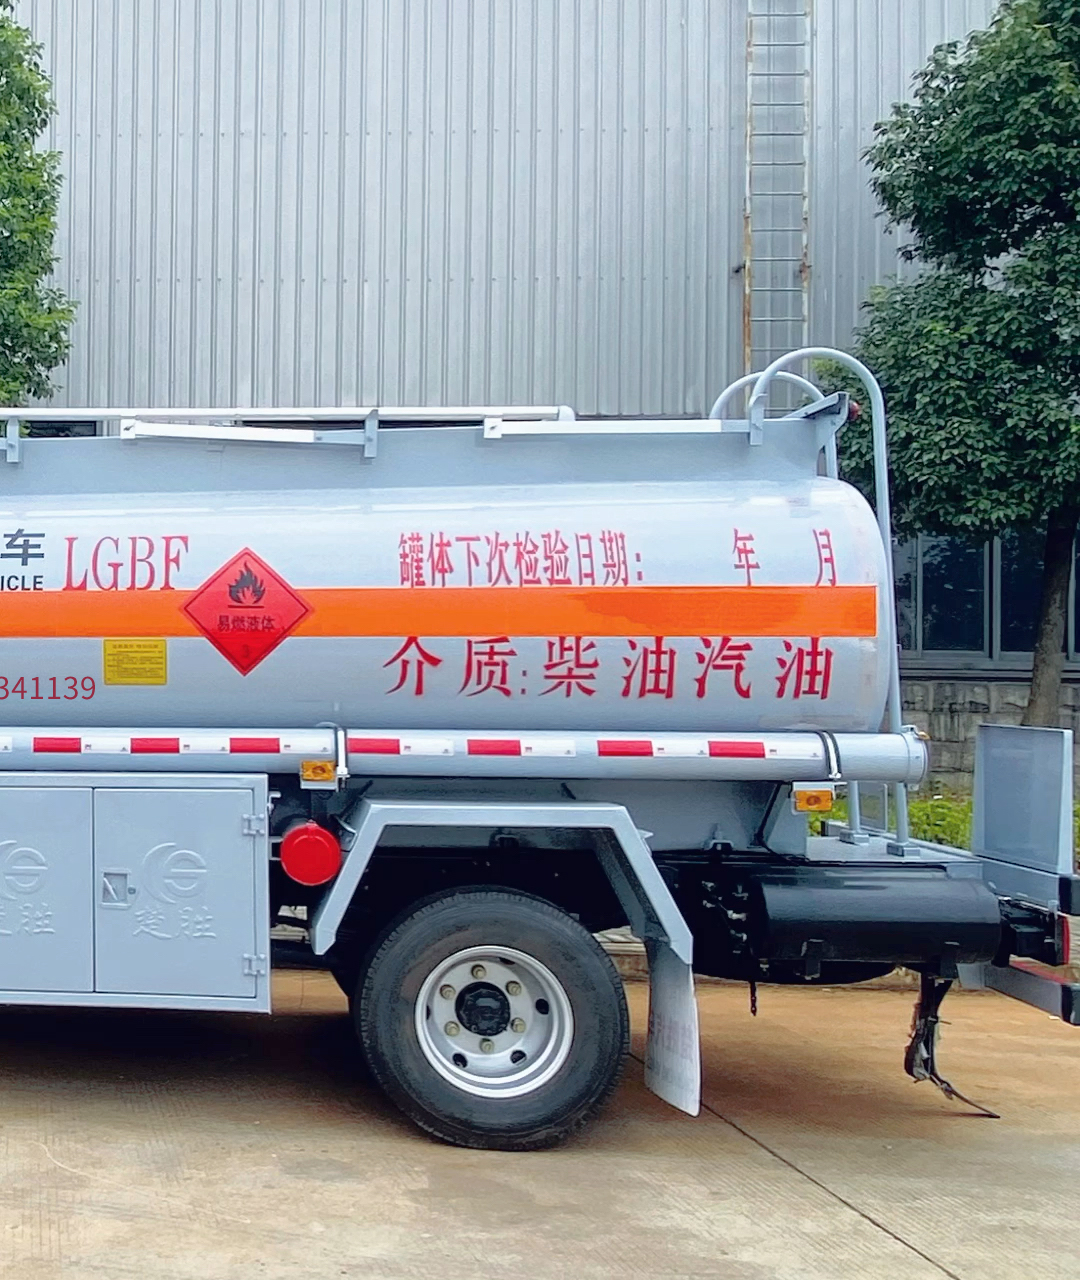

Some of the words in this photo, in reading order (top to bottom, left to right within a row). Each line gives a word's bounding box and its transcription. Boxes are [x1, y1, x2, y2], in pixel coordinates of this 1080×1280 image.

[61, 535, 189, 591] LGBF
[732, 528, 761, 586] 年
[815, 528, 838, 587] 月
[217, 615, 275, 632] 易燃液体
